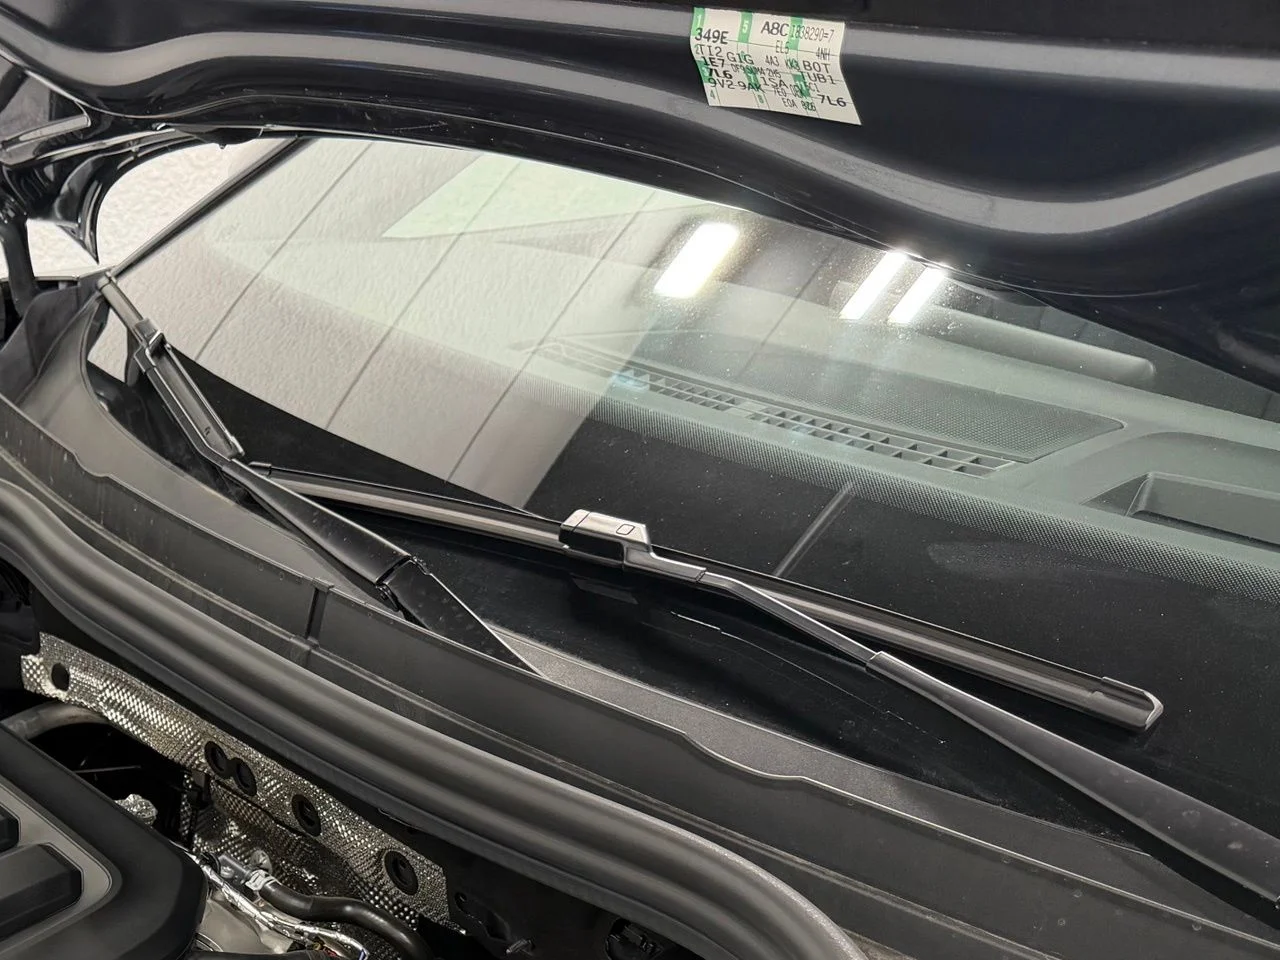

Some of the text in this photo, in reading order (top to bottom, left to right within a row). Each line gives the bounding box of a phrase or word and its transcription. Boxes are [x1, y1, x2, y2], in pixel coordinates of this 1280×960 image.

[694, 27, 729, 45] 349E
[760, 21, 790, 37] A8C
[817, 94, 847, 107] 7L6
